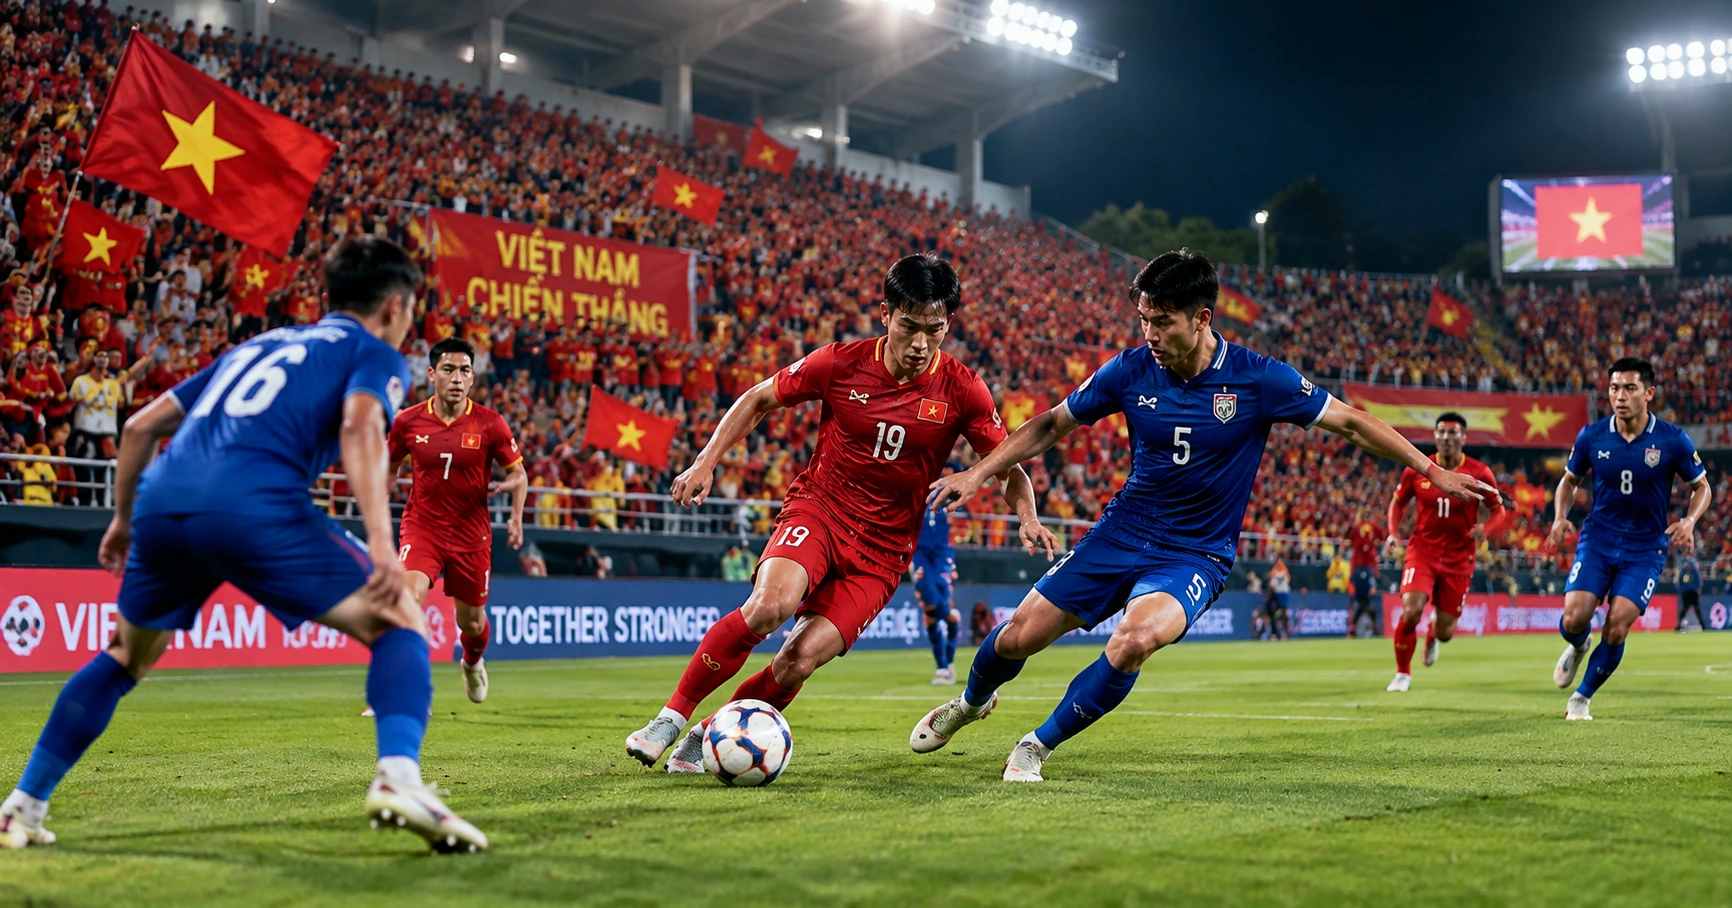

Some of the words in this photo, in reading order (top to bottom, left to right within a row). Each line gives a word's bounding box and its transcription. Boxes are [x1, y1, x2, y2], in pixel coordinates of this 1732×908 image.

[573, 243, 640, 289] NAM
[192, 344, 307, 418] 16
[872, 421, 906, 461] 19
[1172, 426, 1193, 465] 5
[439, 452, 453, 480] 7
[1620, 470, 1633, 495] 8
[1436, 497, 1450, 519] 11
[776, 526, 810, 547] 19
[1568, 562, 1582, 584] 8
[490, 605, 610, 645] TOGETHER
